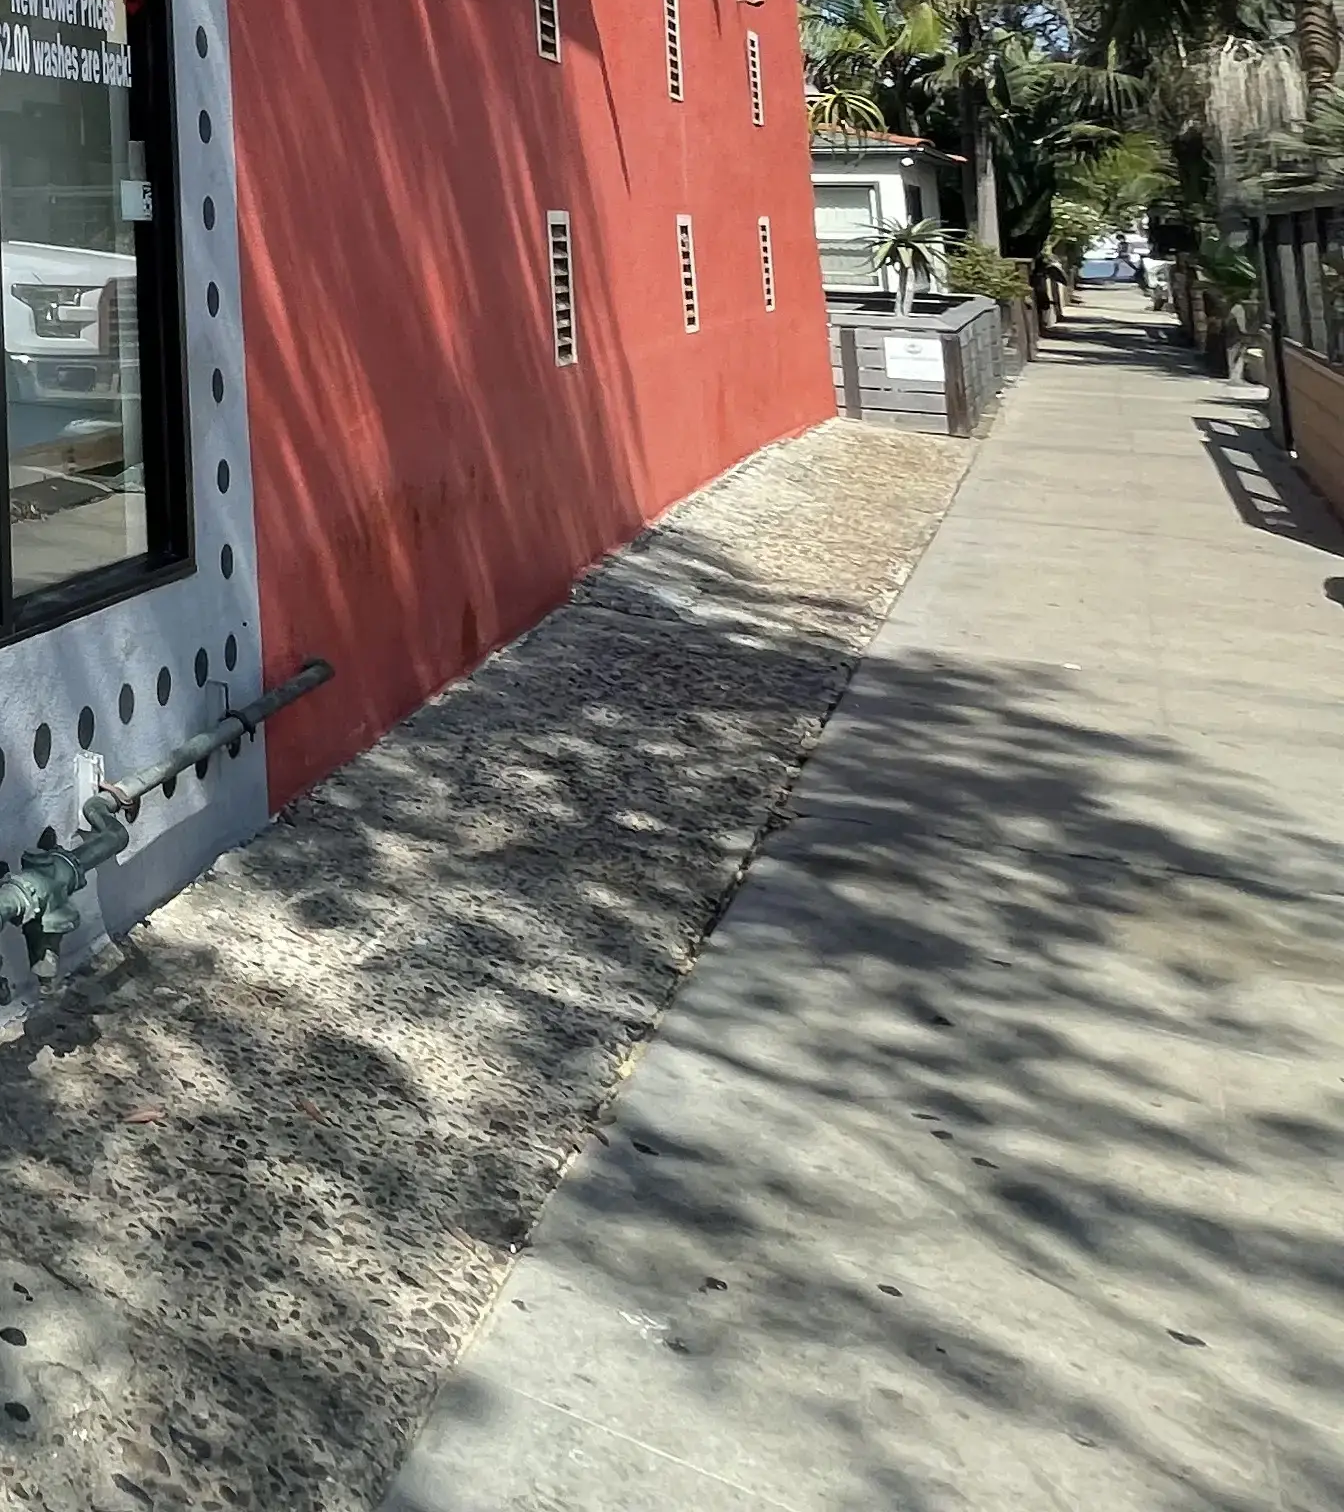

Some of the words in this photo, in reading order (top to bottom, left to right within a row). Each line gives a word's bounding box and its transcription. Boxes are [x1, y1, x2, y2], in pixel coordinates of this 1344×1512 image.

[32, 32, 79, 81] washes
[81, 48, 100, 84] are
[101, 40, 133, 88] back!
